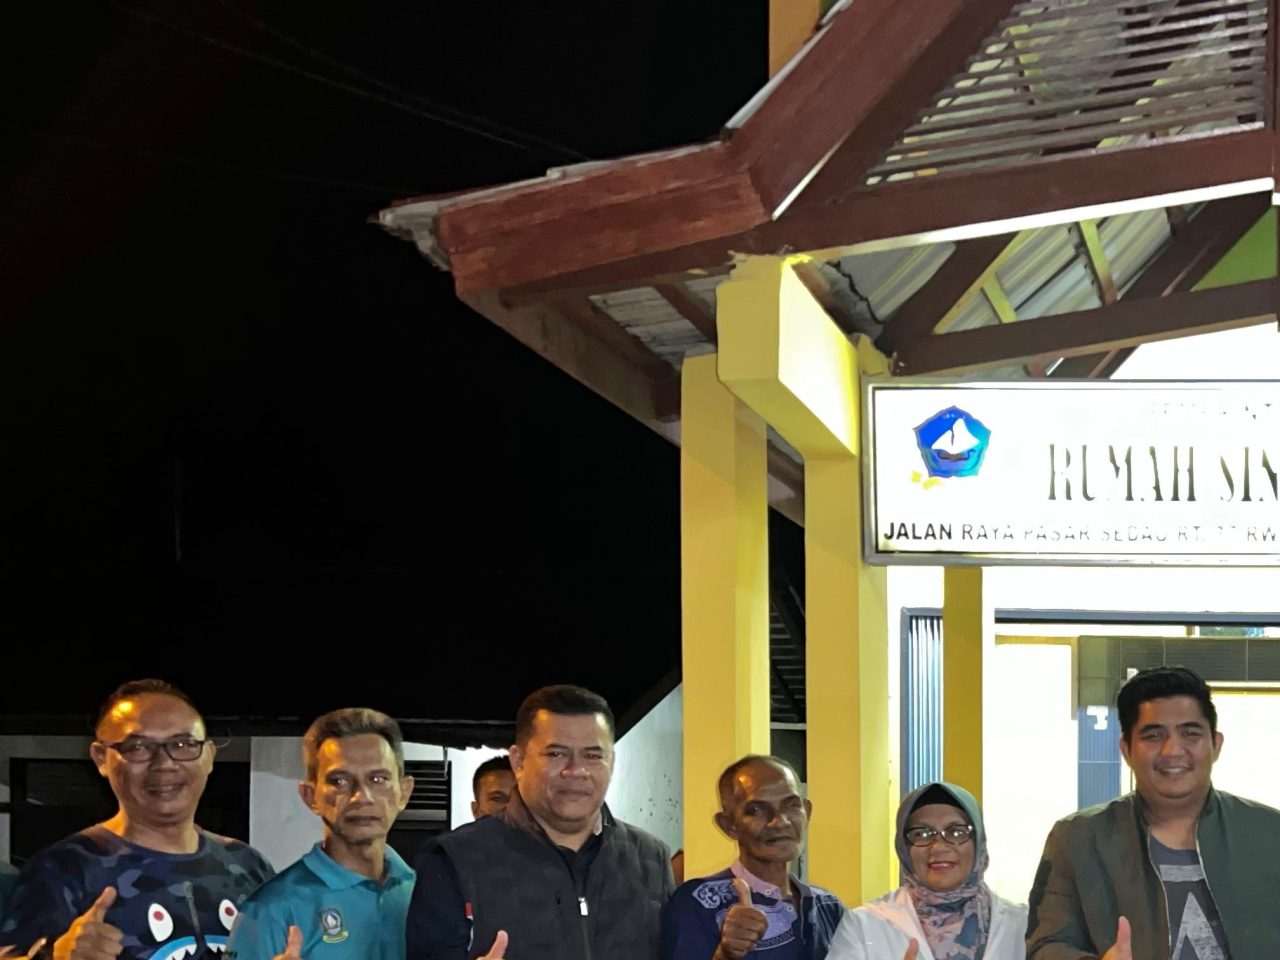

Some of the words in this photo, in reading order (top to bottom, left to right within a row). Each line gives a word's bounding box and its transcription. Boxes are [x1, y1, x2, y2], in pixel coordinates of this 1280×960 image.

[1047, 443, 1197, 502] RUMAH
[884, 522, 953, 541] JALAN
[962, 523, 1015, 541] RAYA
